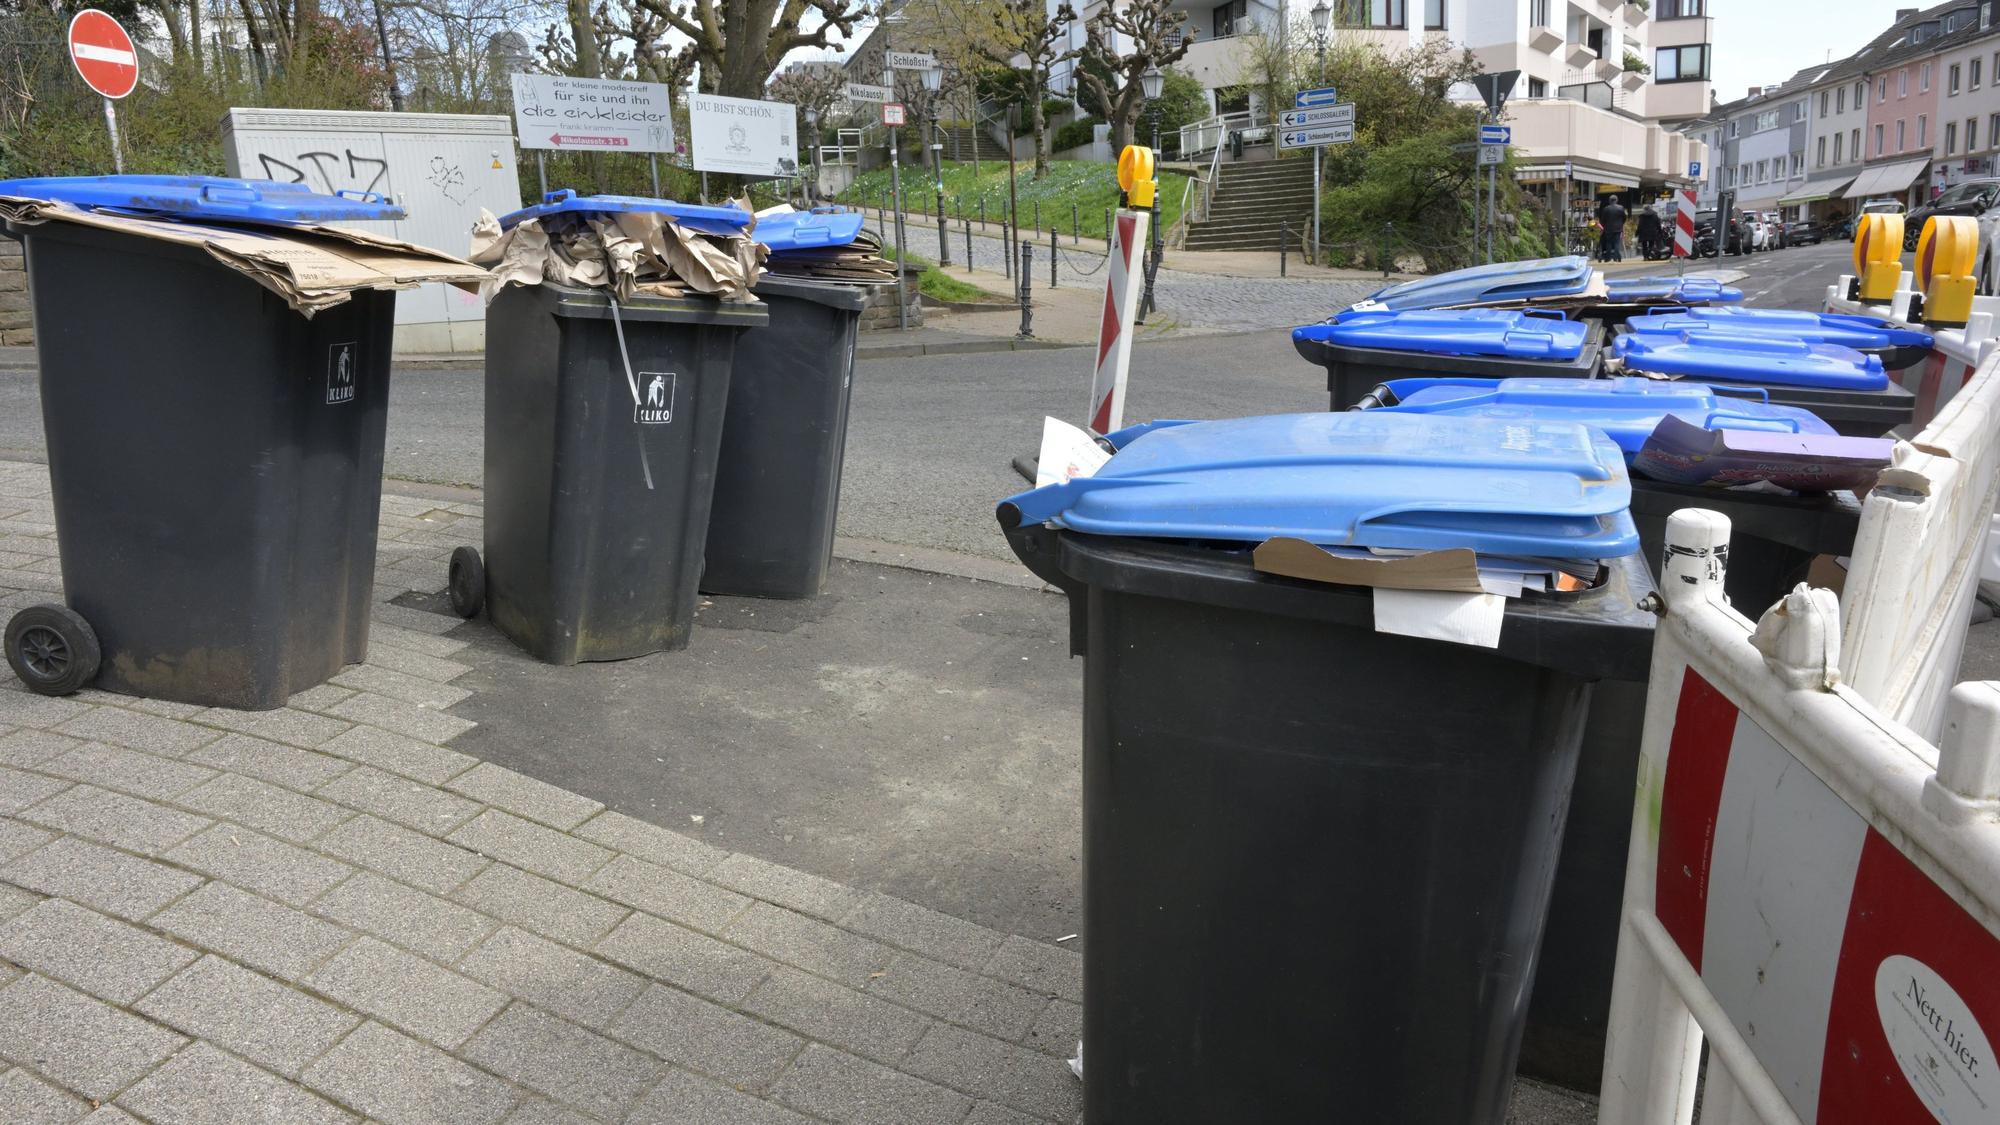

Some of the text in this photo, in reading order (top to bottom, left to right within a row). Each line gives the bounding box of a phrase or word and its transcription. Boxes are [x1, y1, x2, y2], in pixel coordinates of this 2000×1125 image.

[572, 81, 599, 90] kleine
[601, 83, 648, 93] mode-treff
[554, 90, 650, 105] für sie und ihn
[522, 104, 557, 117] die
[696, 101, 711, 112] DU
[713, 103, 736, 114] BIST
[1307, 110, 1350, 120] SCHLOSSGALERIE
[559, 122, 581, 130] frank
[1334, 130, 1350, 138] Garage
[560, 136, 607, 145] Nikolausstr.
[329, 385, 353, 401] KLIKO
[1906, 975, 1943, 1033] Nett
[1944, 1020, 1979, 1079] hier.
